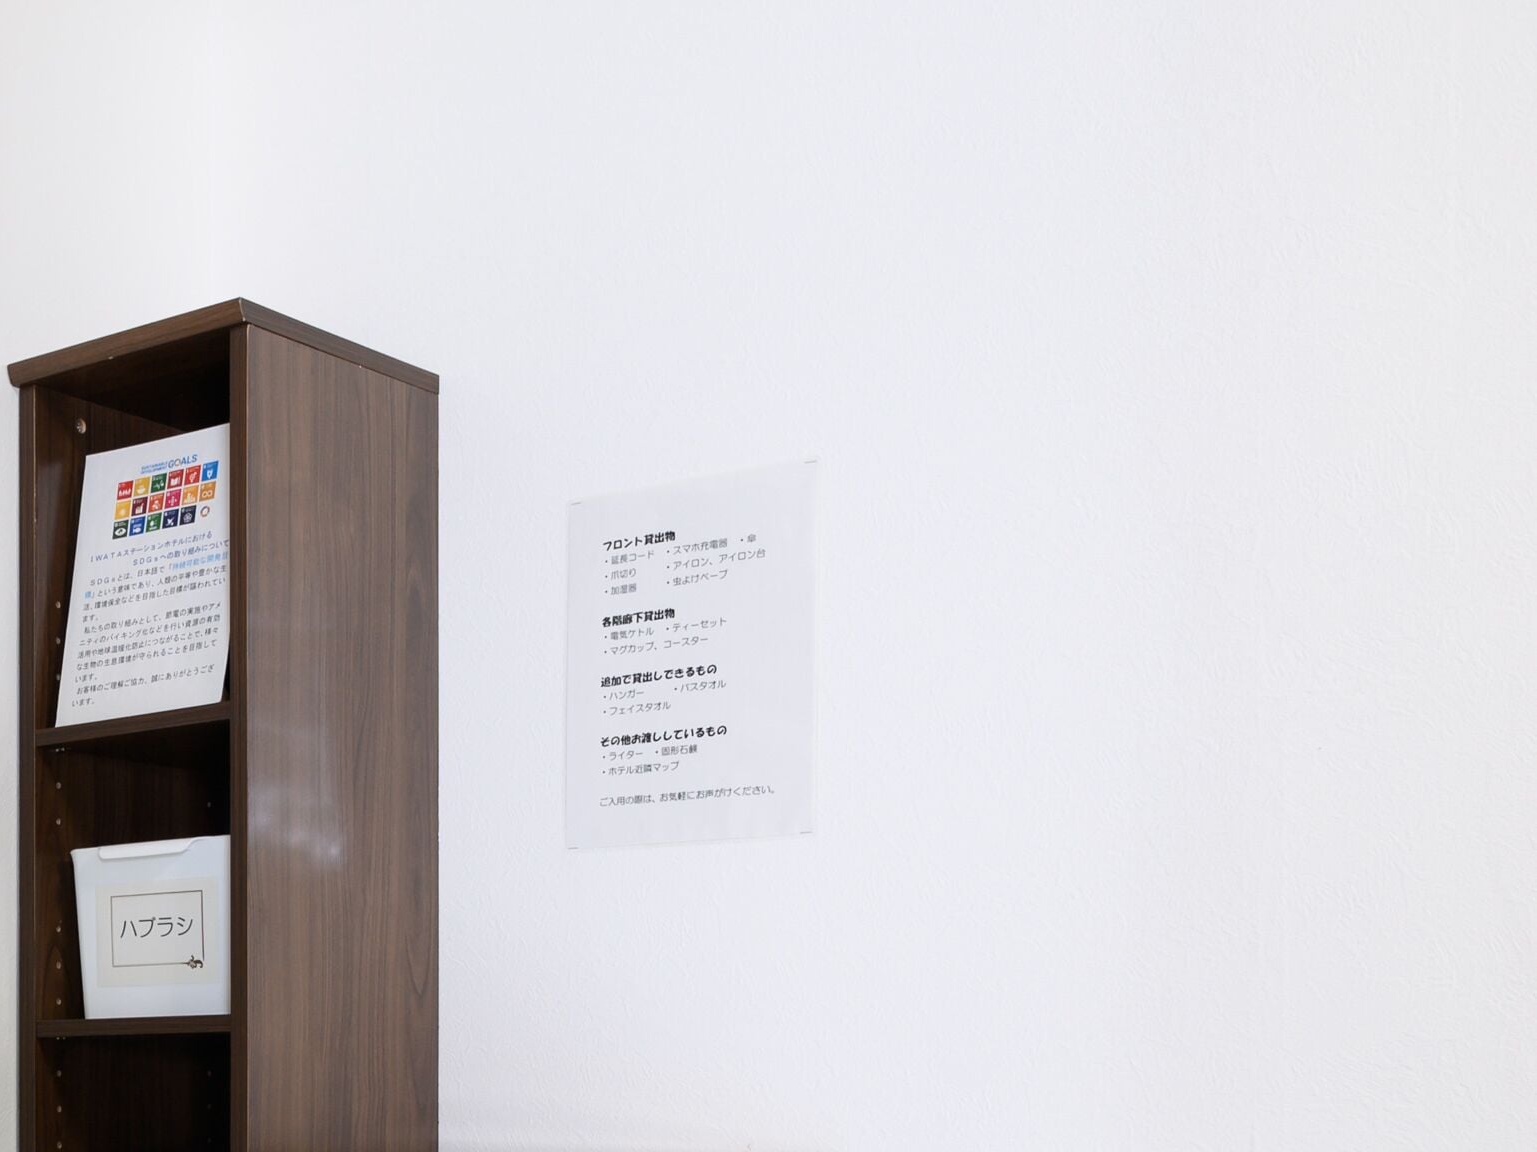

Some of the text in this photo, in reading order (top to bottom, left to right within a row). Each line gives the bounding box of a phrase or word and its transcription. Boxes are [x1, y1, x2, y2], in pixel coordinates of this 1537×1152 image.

[168, 454, 198, 469] GOALS
[603, 531, 676, 551] フロント貸出物
[602, 608, 676, 628] 各階廊下貸出物
[600, 664, 718, 688] 追加で貸出しできるもの
[600, 725, 728, 747] その他お渡ししているもの
[120, 916, 194, 939] ハブラシ
